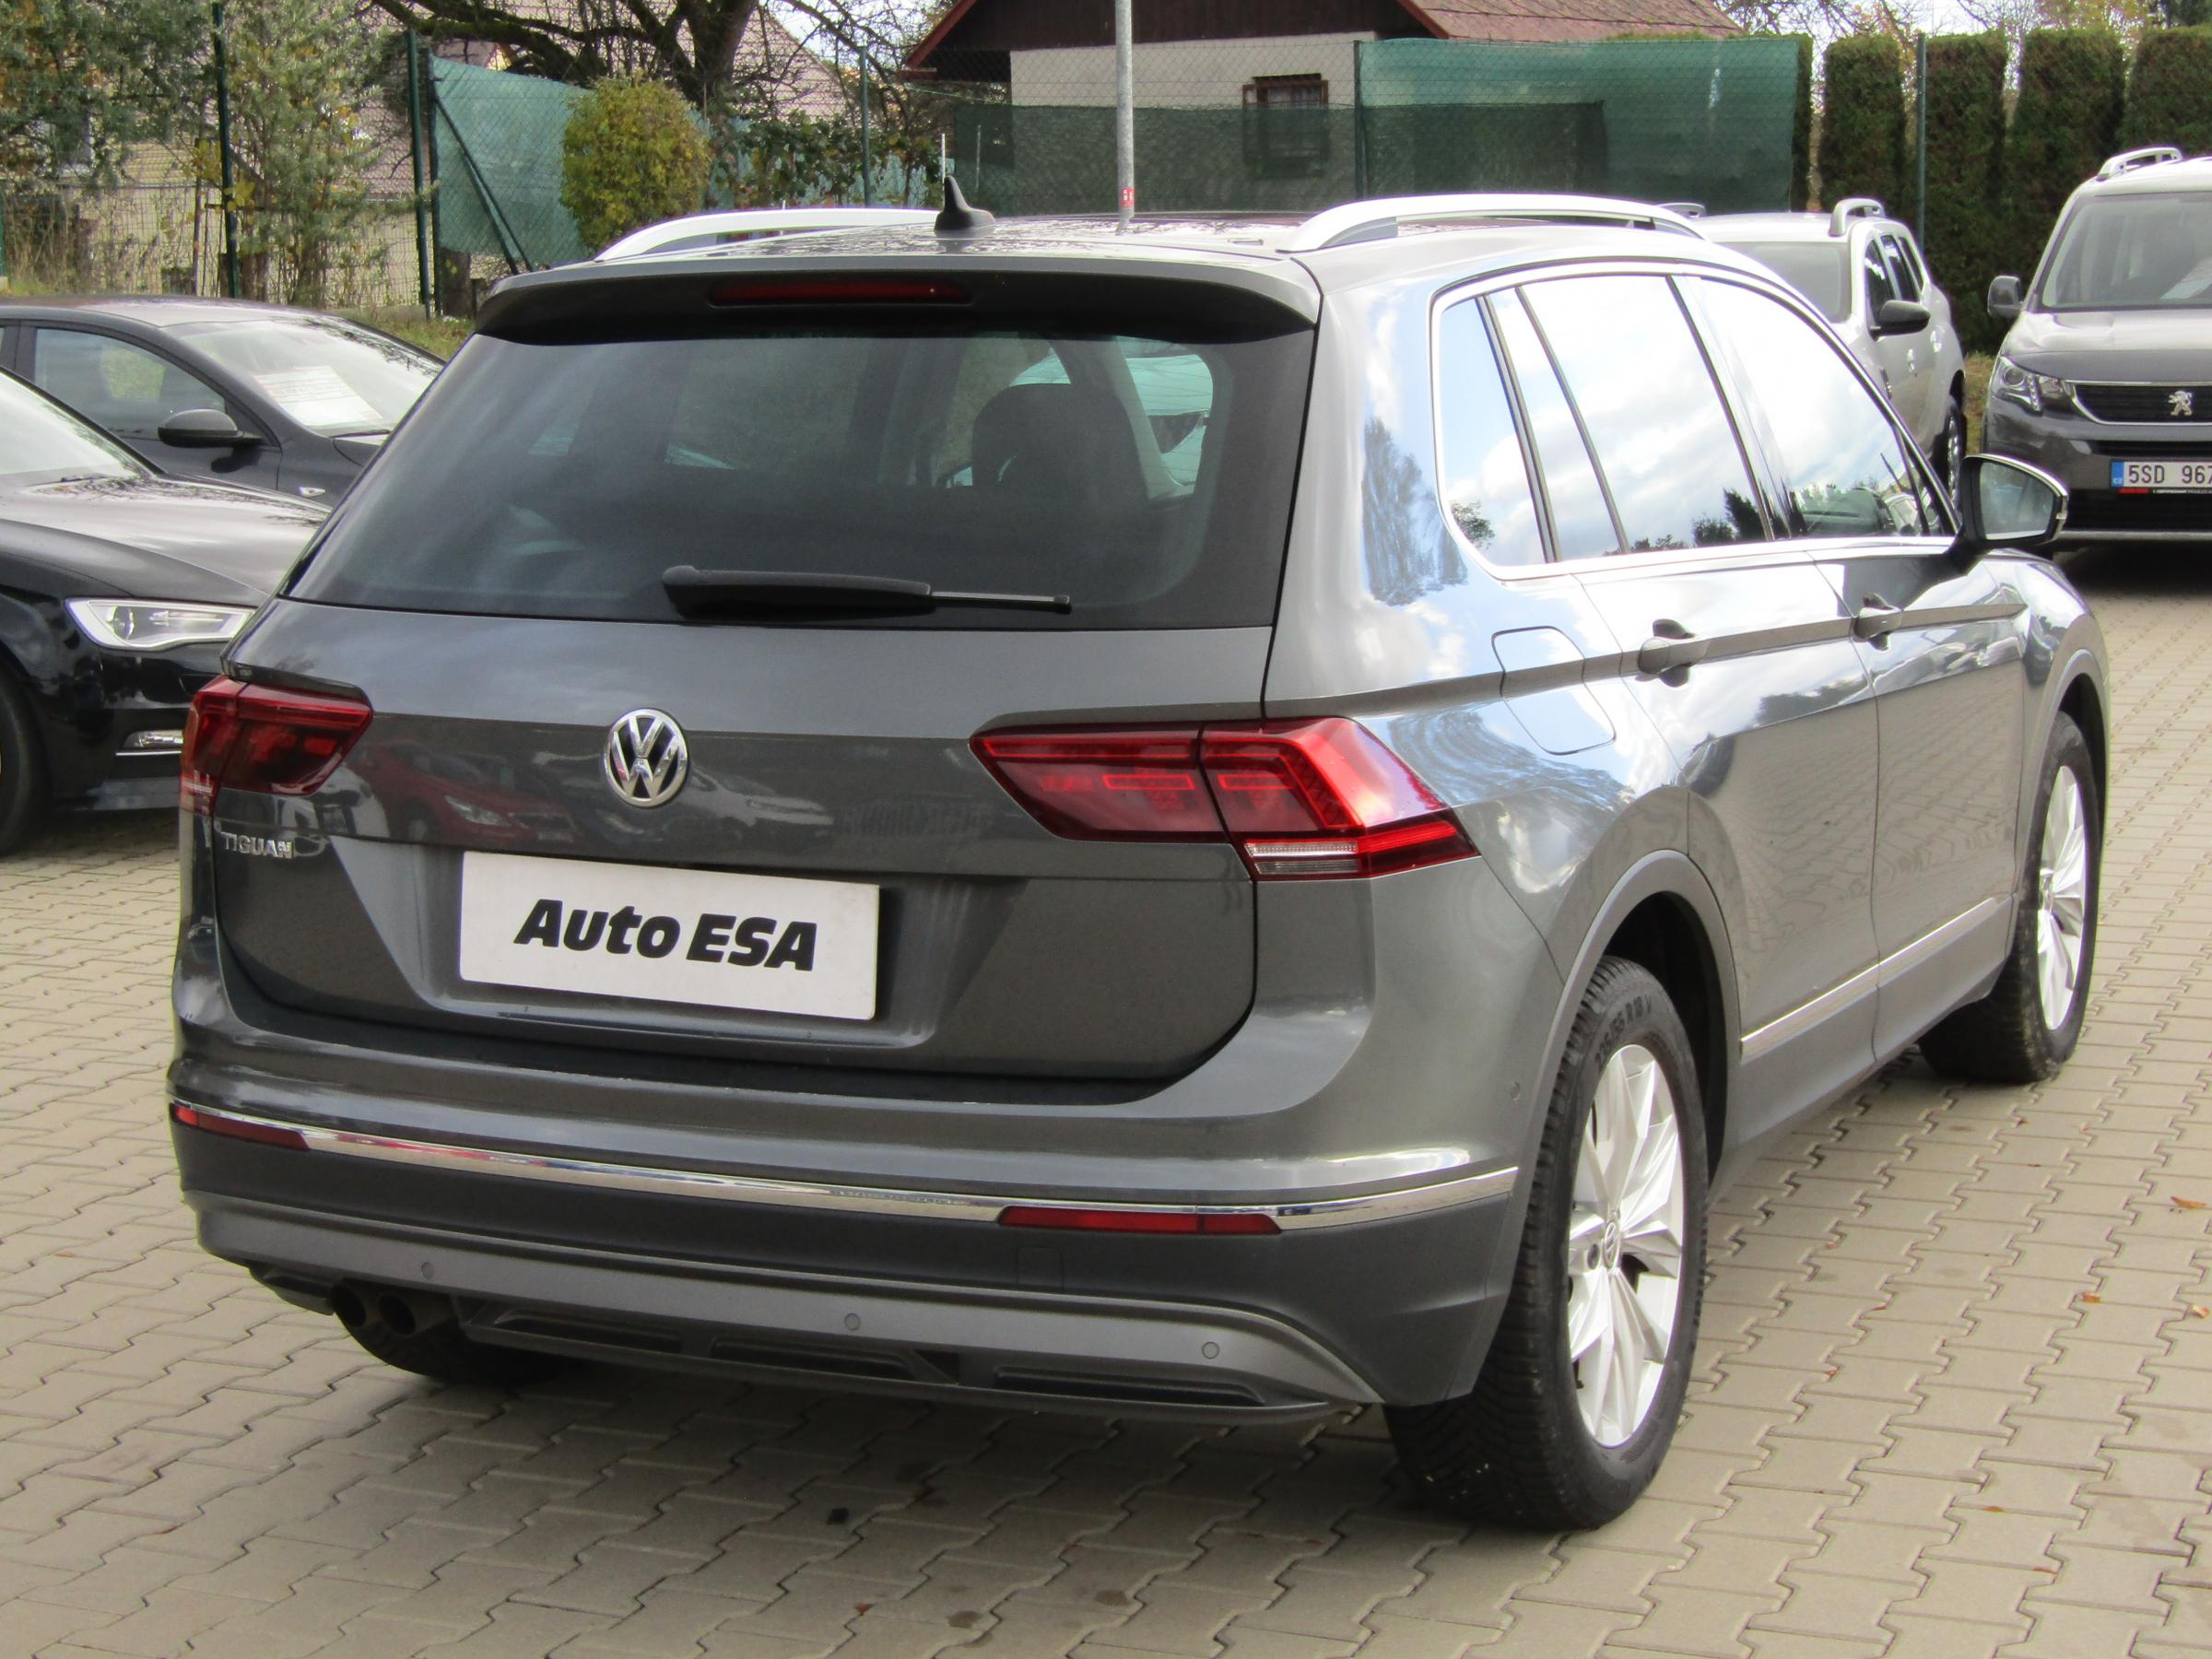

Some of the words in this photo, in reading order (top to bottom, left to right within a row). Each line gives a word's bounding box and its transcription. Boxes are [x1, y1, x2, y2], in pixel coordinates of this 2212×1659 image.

[2128, 465, 2165, 484] 5SD
[220, 831, 292, 859] TIGUAN
[513, 899, 681, 959] Auto
[686, 912, 818, 971] ESA
